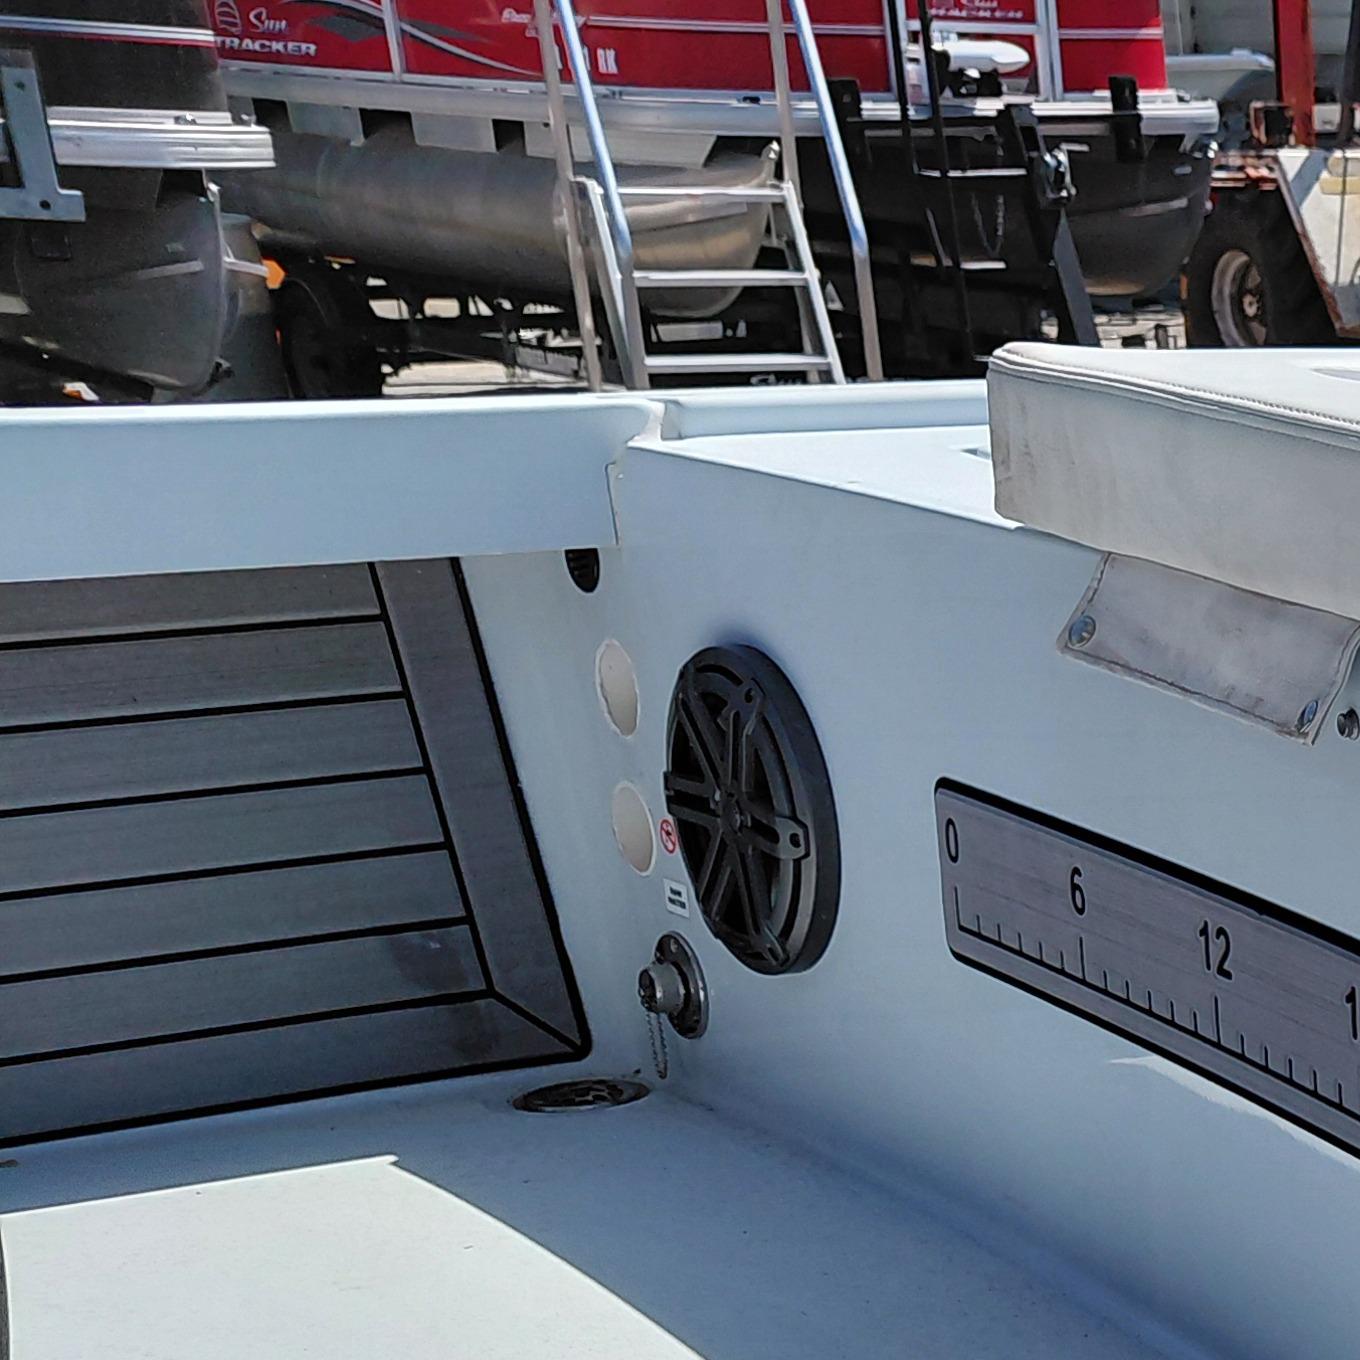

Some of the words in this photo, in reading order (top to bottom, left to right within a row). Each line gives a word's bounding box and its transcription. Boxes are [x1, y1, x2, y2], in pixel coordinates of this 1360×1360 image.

[214, 36, 317, 57] TRACKER
[945, 817, 960, 864] 0
[1069, 866, 1087, 916] 6
[1200, 919, 1233, 981] 12
